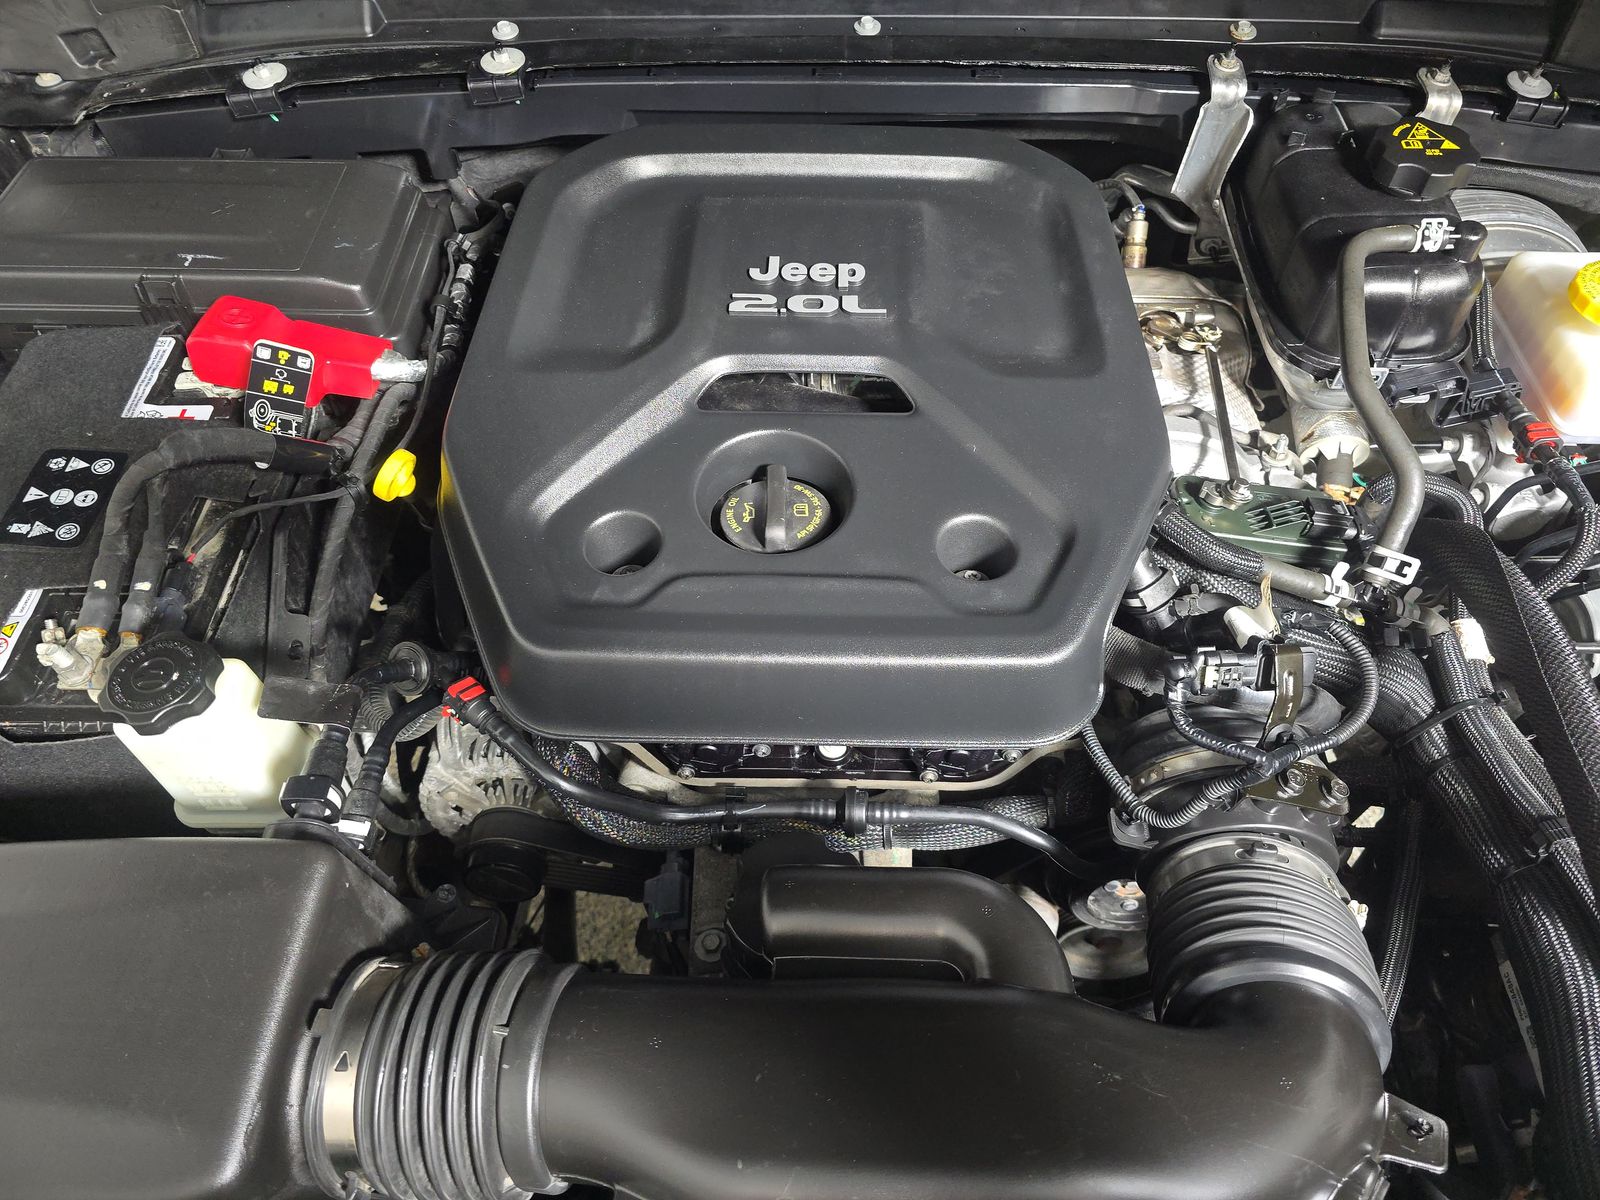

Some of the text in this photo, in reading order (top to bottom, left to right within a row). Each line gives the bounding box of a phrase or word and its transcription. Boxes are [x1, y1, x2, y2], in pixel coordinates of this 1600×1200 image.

[749, 255, 866, 291] Jeep
[728, 293, 888, 317] 2.0L
[725, 497, 743, 533] ENGINE OIL
